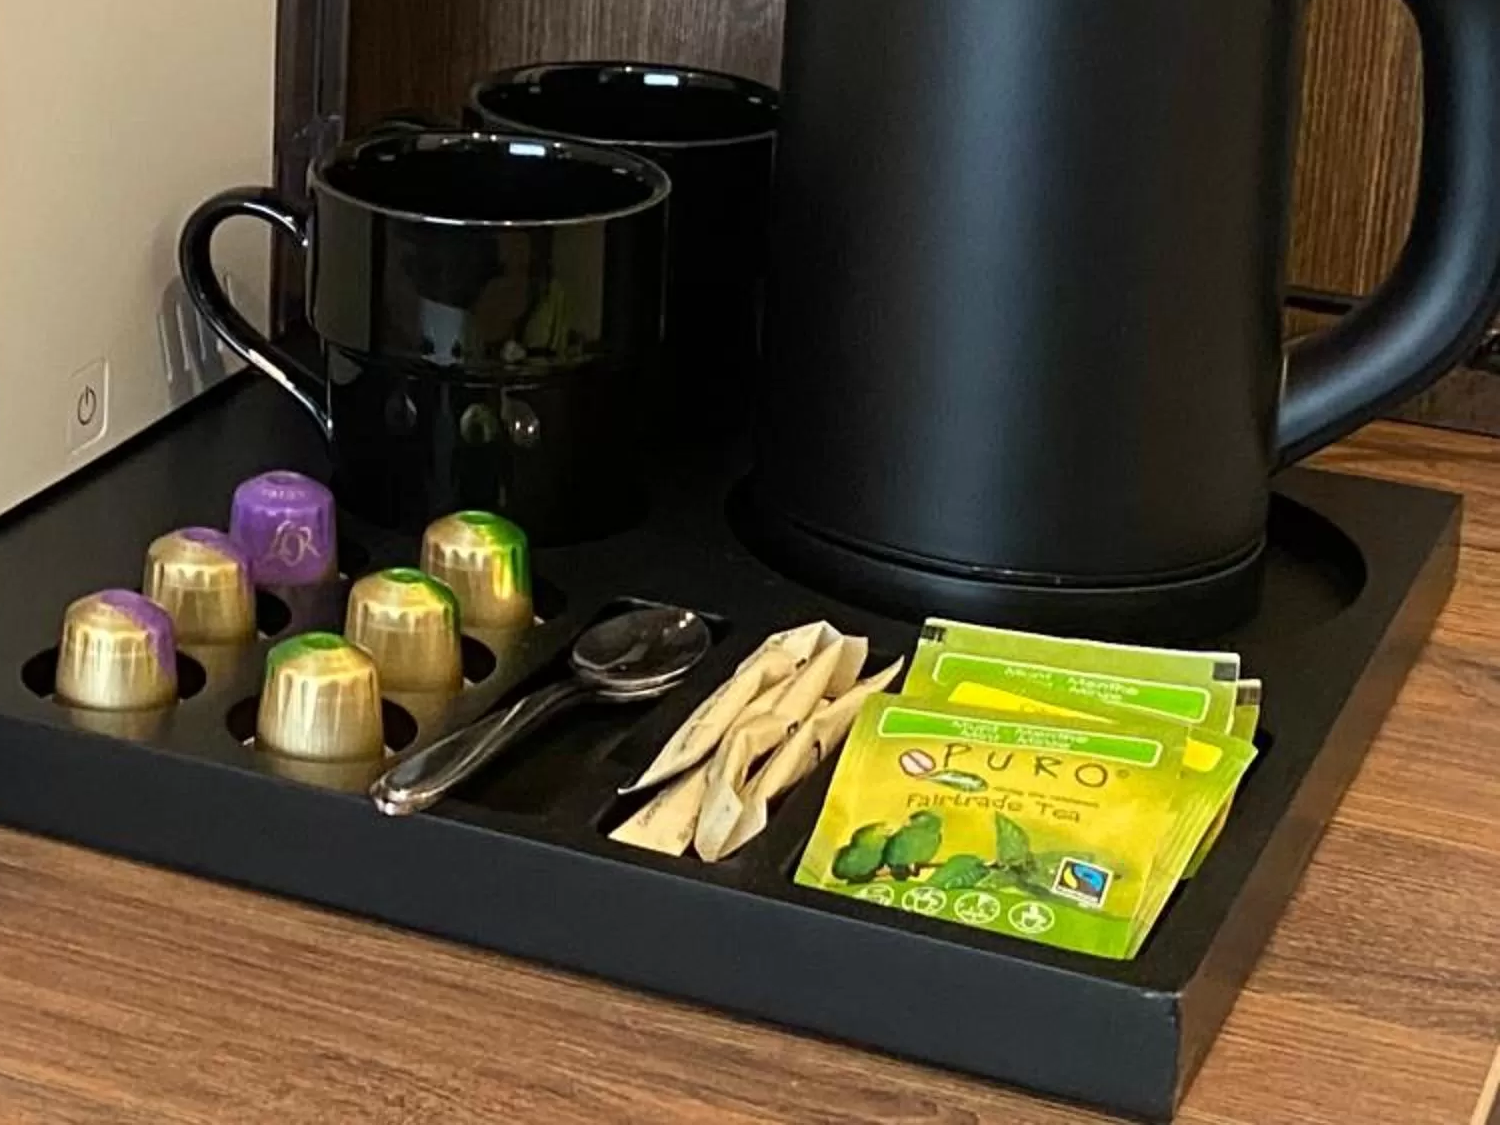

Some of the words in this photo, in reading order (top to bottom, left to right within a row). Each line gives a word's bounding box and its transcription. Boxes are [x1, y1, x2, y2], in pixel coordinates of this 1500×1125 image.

[943, 742, 1108, 788] PURO
[906, 792, 1023, 812] Fairtrade
[1035, 800, 1080, 823] Tea
